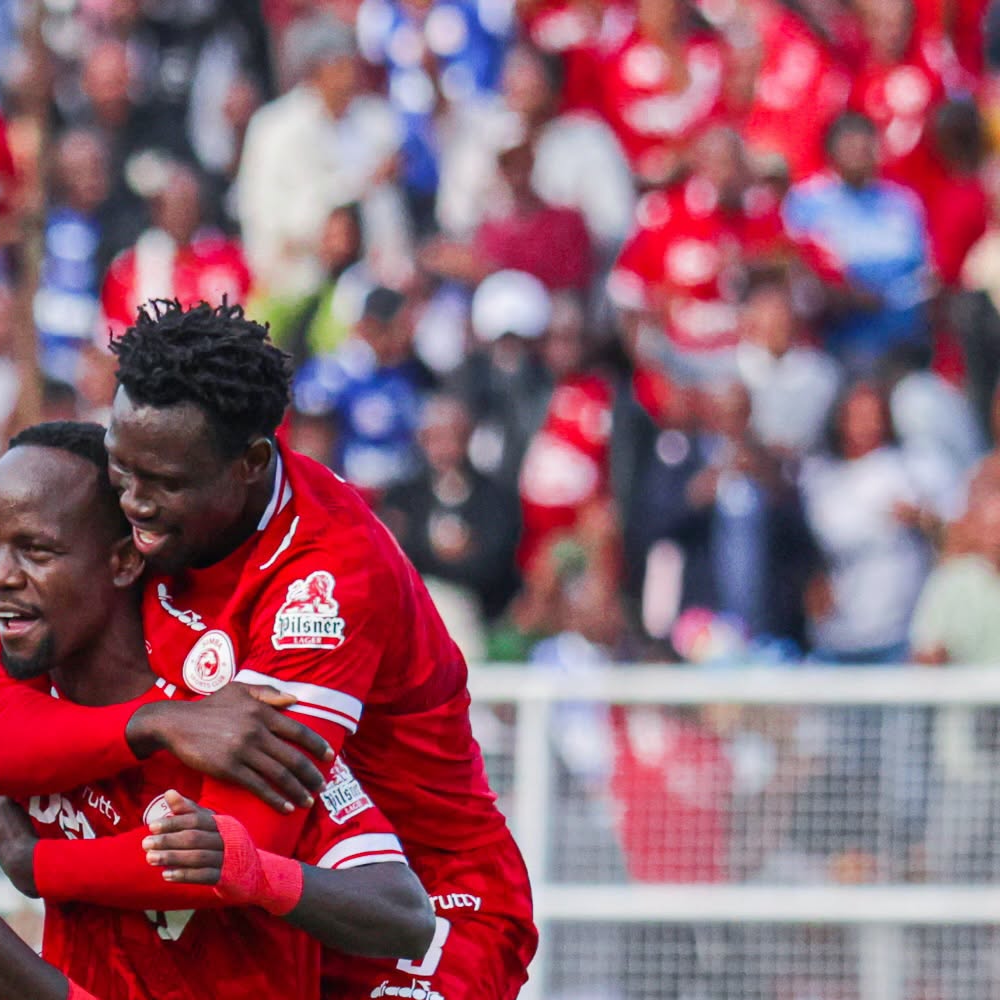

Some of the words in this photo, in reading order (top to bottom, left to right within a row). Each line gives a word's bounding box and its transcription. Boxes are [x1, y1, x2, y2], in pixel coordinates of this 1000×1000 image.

[279, 616, 341, 638] Pilsner
[82, 786, 121, 826] rutty
[323, 784, 361, 813] Pils
[428, 893, 481, 911] rutty
